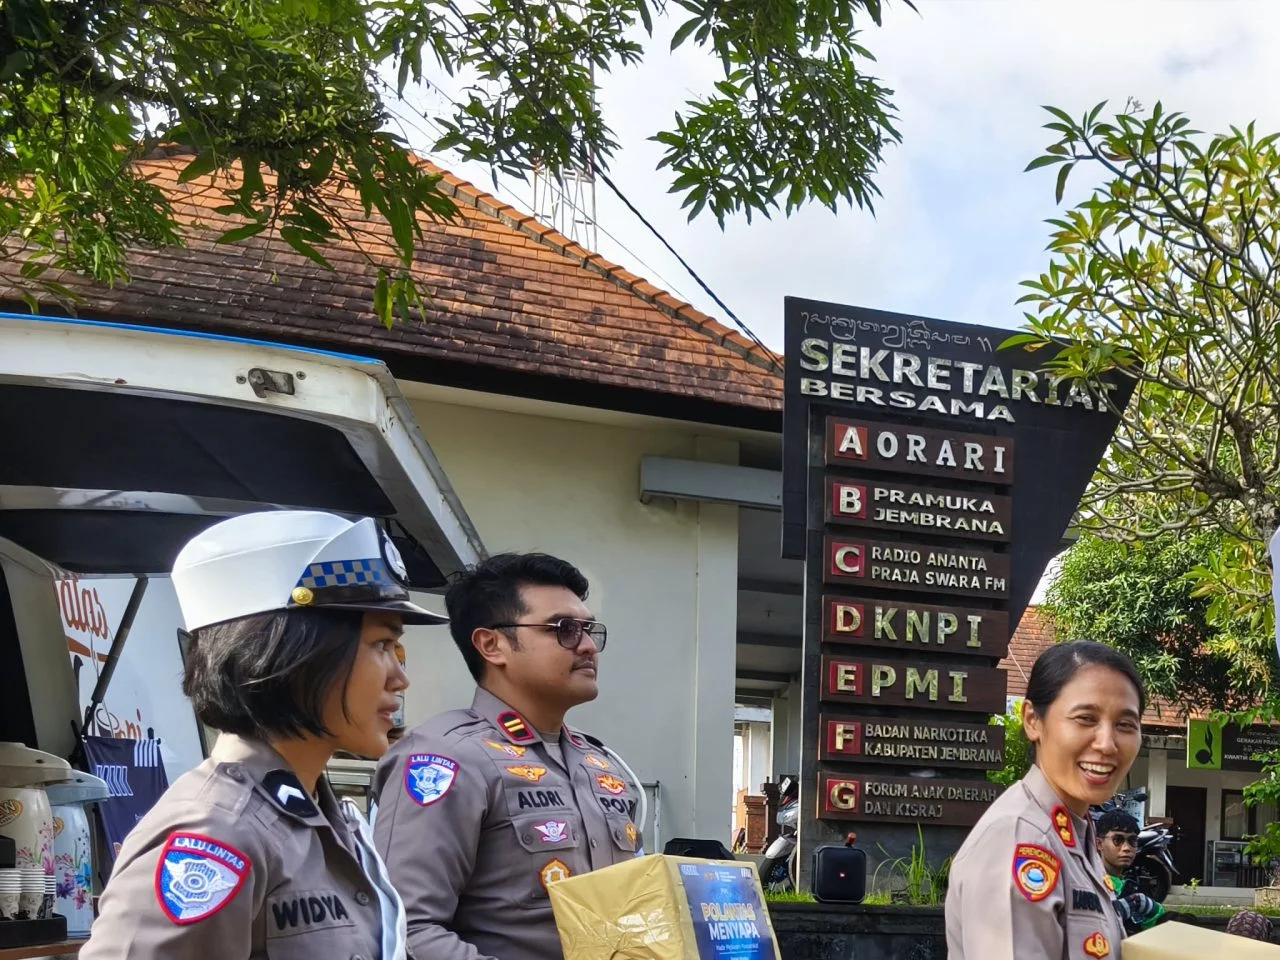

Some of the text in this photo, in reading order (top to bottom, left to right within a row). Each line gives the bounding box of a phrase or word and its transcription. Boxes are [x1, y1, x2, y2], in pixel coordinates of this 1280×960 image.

[800, 377, 1016, 423] BERSAMA
[838, 426, 1006, 473] A ORARI
[839, 486, 862, 514] B
[874, 487, 995, 514] PRAMUKA
[873, 508, 1004, 534] JEMBRANA
[835, 549, 860, 573] C
[871, 546, 988, 572] RADIO ANANTA
[871, 565, 1006, 592] PRAJA SWARA FM
[835, 604, 983, 648] D KNPI
[836, 664, 969, 703] E PMI
[835, 723, 856, 750] F
[865, 723, 988, 743] BADAN NARKOTIKA
[411, 755, 456, 770] LALU LINTAS
[864, 742, 1003, 763] KABUPATEN JEMBRANA
[517, 790, 565, 810] ALDRI
[830, 782, 856, 810] G
[864, 782, 997, 802] FORUM ANAK DAERAH
[864, 801, 943, 818] DAN KISRAJ
[174, 837, 245, 870] LALU LINTAS
[271, 894, 349, 931] WIDYA
[701, 902, 757, 922] POLANTAS
[708, 922, 760, 941] MENYAPA
